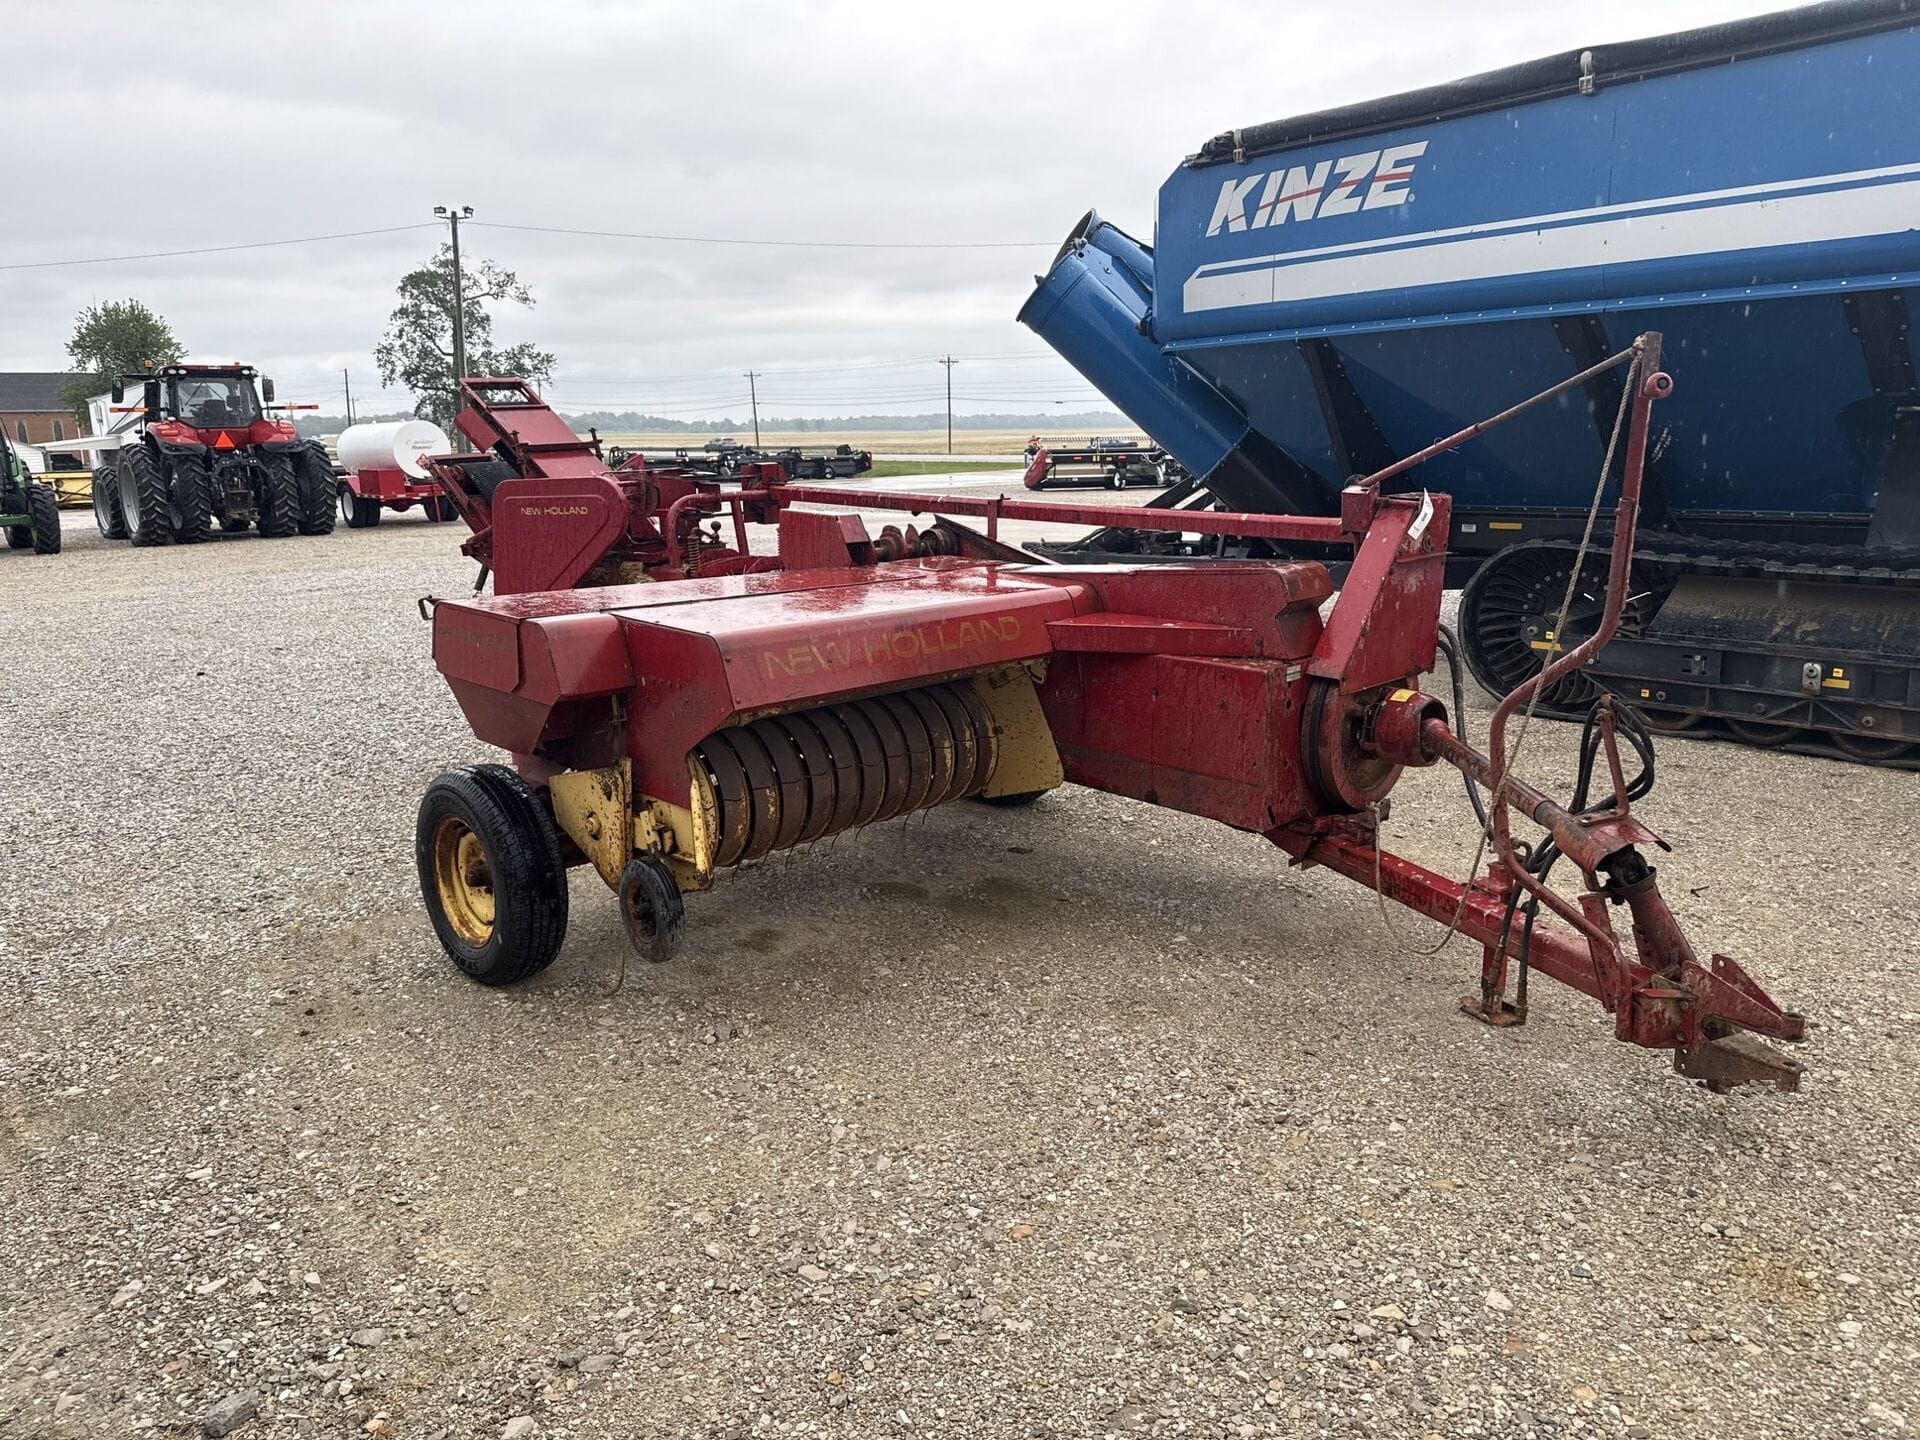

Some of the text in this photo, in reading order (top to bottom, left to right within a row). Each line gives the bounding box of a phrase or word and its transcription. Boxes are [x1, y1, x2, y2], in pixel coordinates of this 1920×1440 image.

[1205, 140, 1429, 237] KINZE
[520, 506, 589, 516] NEW HOLLAND
[763, 615, 1021, 680] NEW HOLLAND
